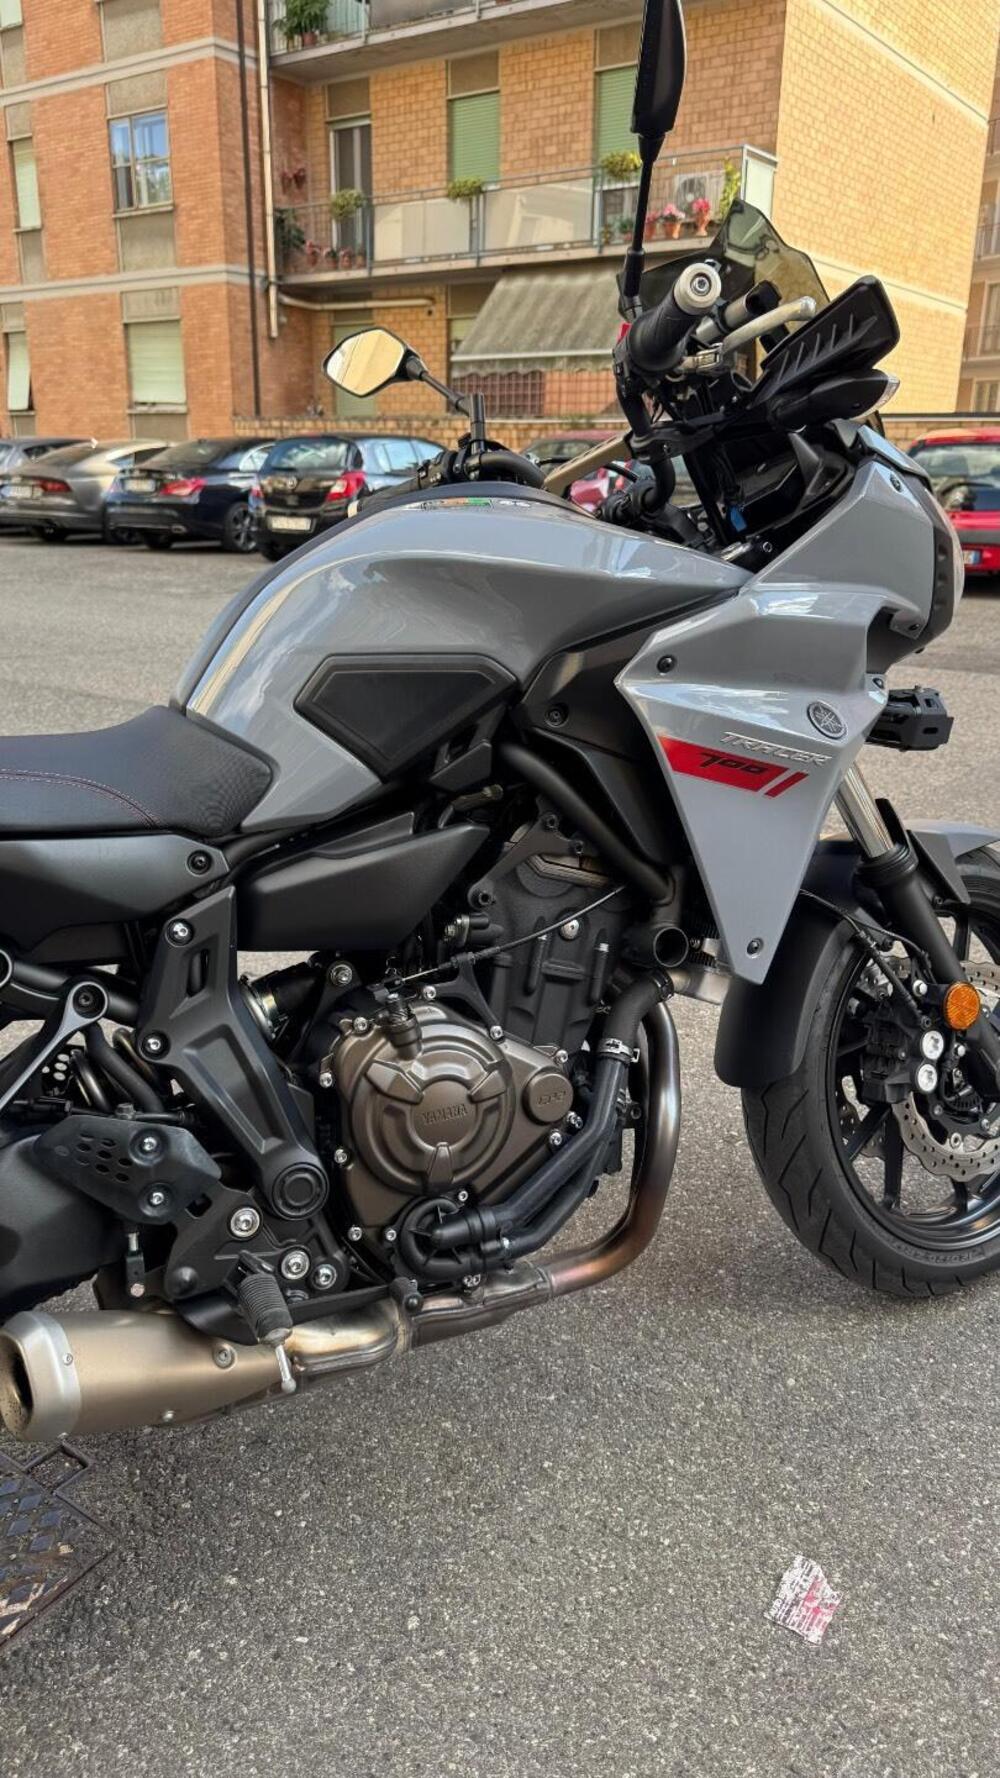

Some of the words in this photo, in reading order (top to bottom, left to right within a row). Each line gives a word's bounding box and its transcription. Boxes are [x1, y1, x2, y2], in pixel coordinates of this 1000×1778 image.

[720, 731, 832, 765] TRACER
[698, 752, 769, 774] 700
[422, 1103, 468, 1123] YAMAHA
